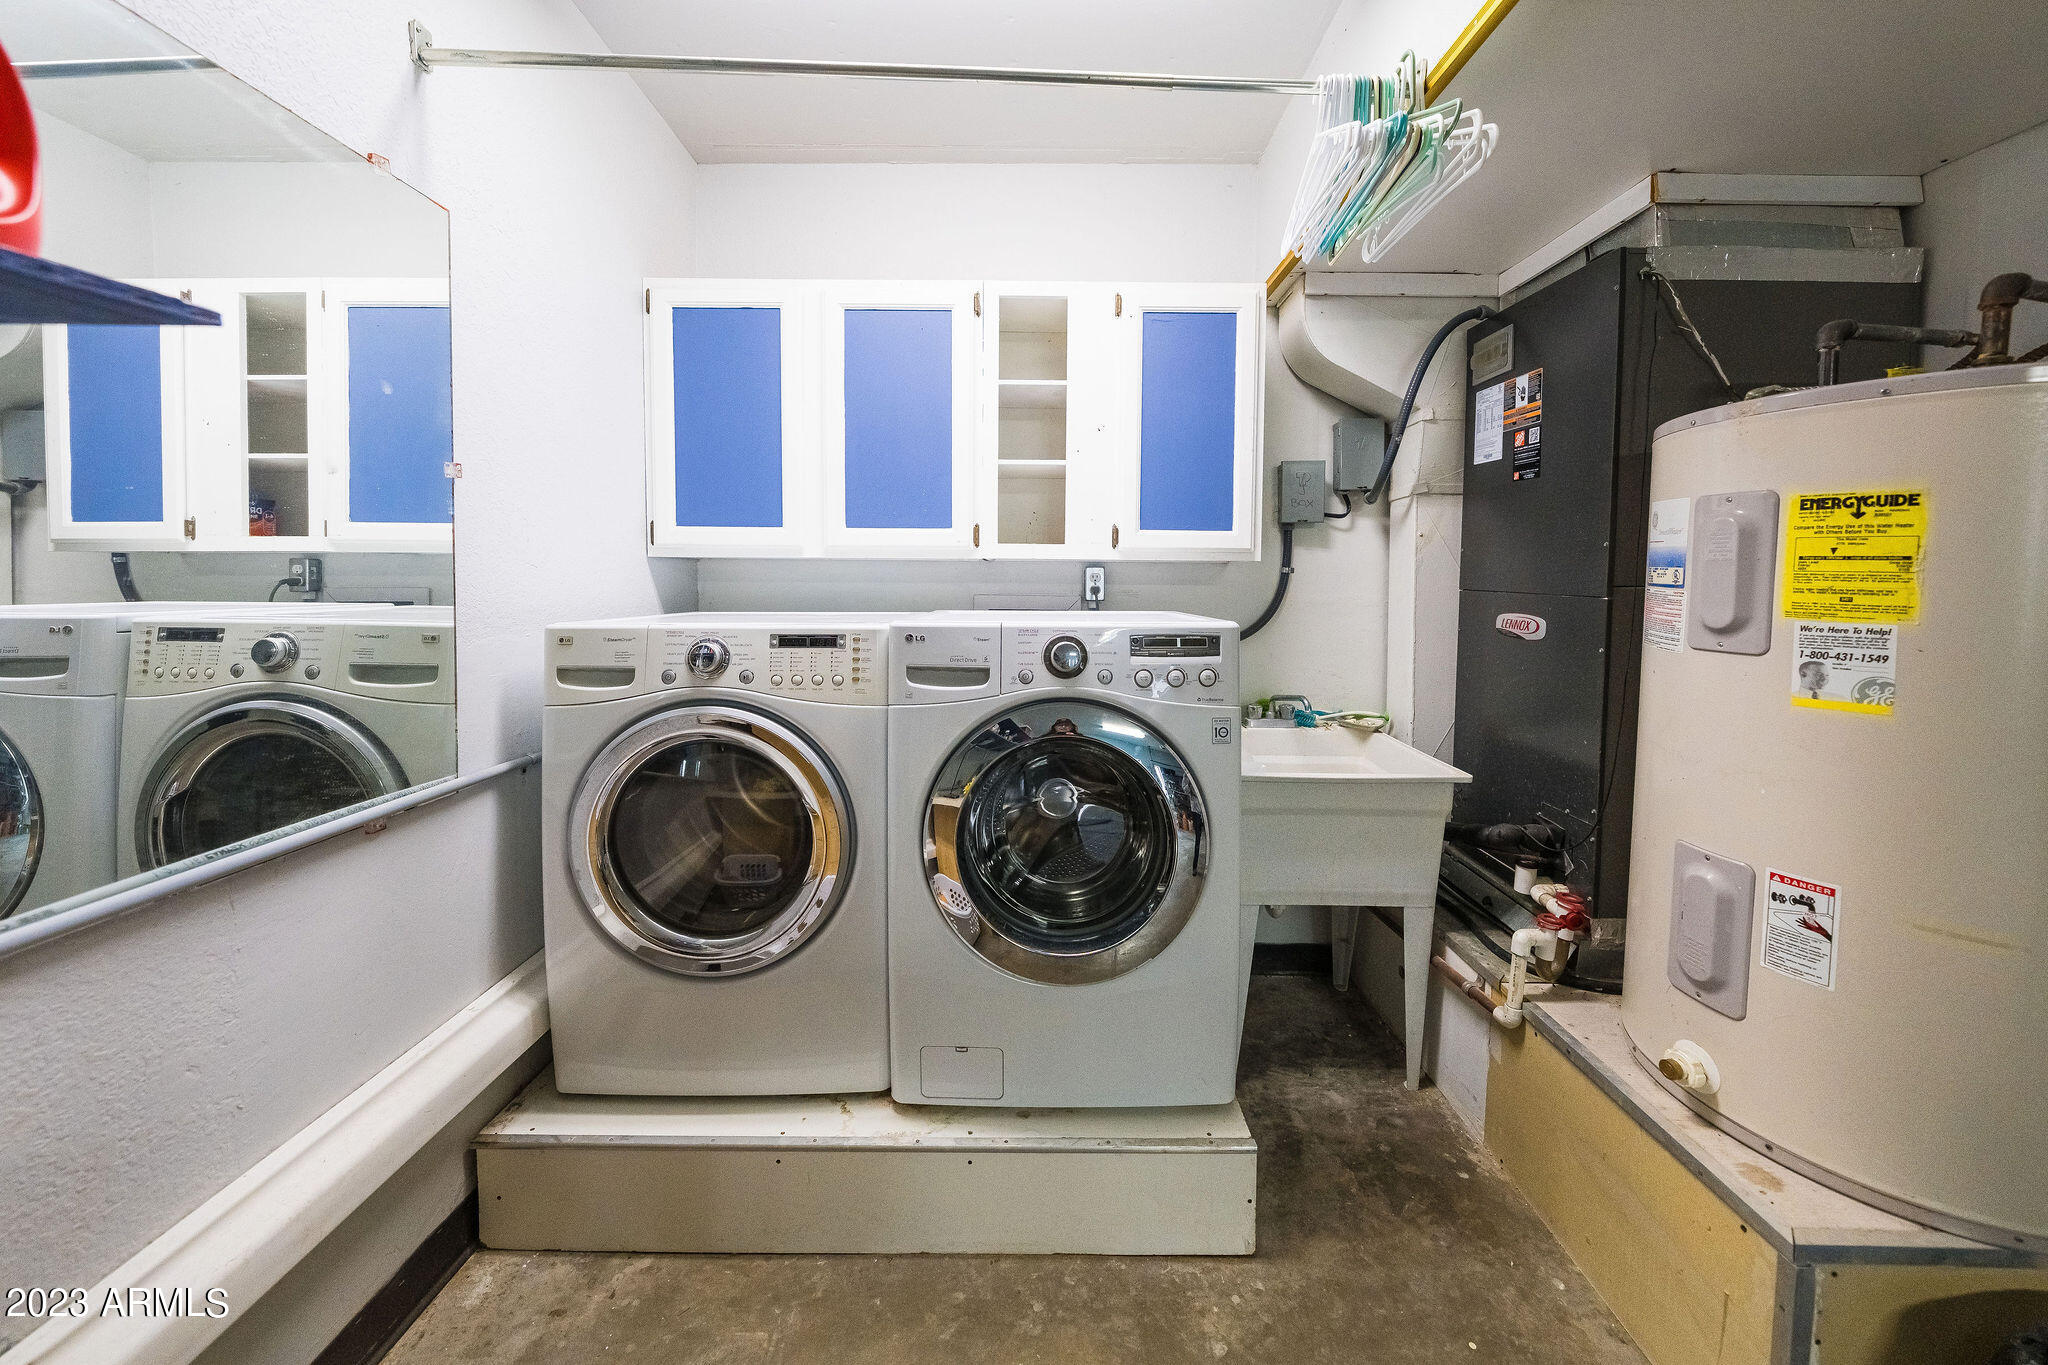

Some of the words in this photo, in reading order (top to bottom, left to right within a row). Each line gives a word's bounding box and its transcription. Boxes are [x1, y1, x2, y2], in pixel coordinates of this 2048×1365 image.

[1800, 493, 1921, 519] ENERGYGUIDE
[1501, 618, 1532, 631] LENNOX
[1800, 625, 1825, 633] We're
[1828, 626, 1849, 634] Here
[1853, 627, 1863, 635] To
[1866, 628, 1892, 637] Help!
[1799, 650, 1890, 664] 1-800-431-1549
[1214, 727, 1229, 738] 10
[1784, 877, 1832, 895] DANGER
